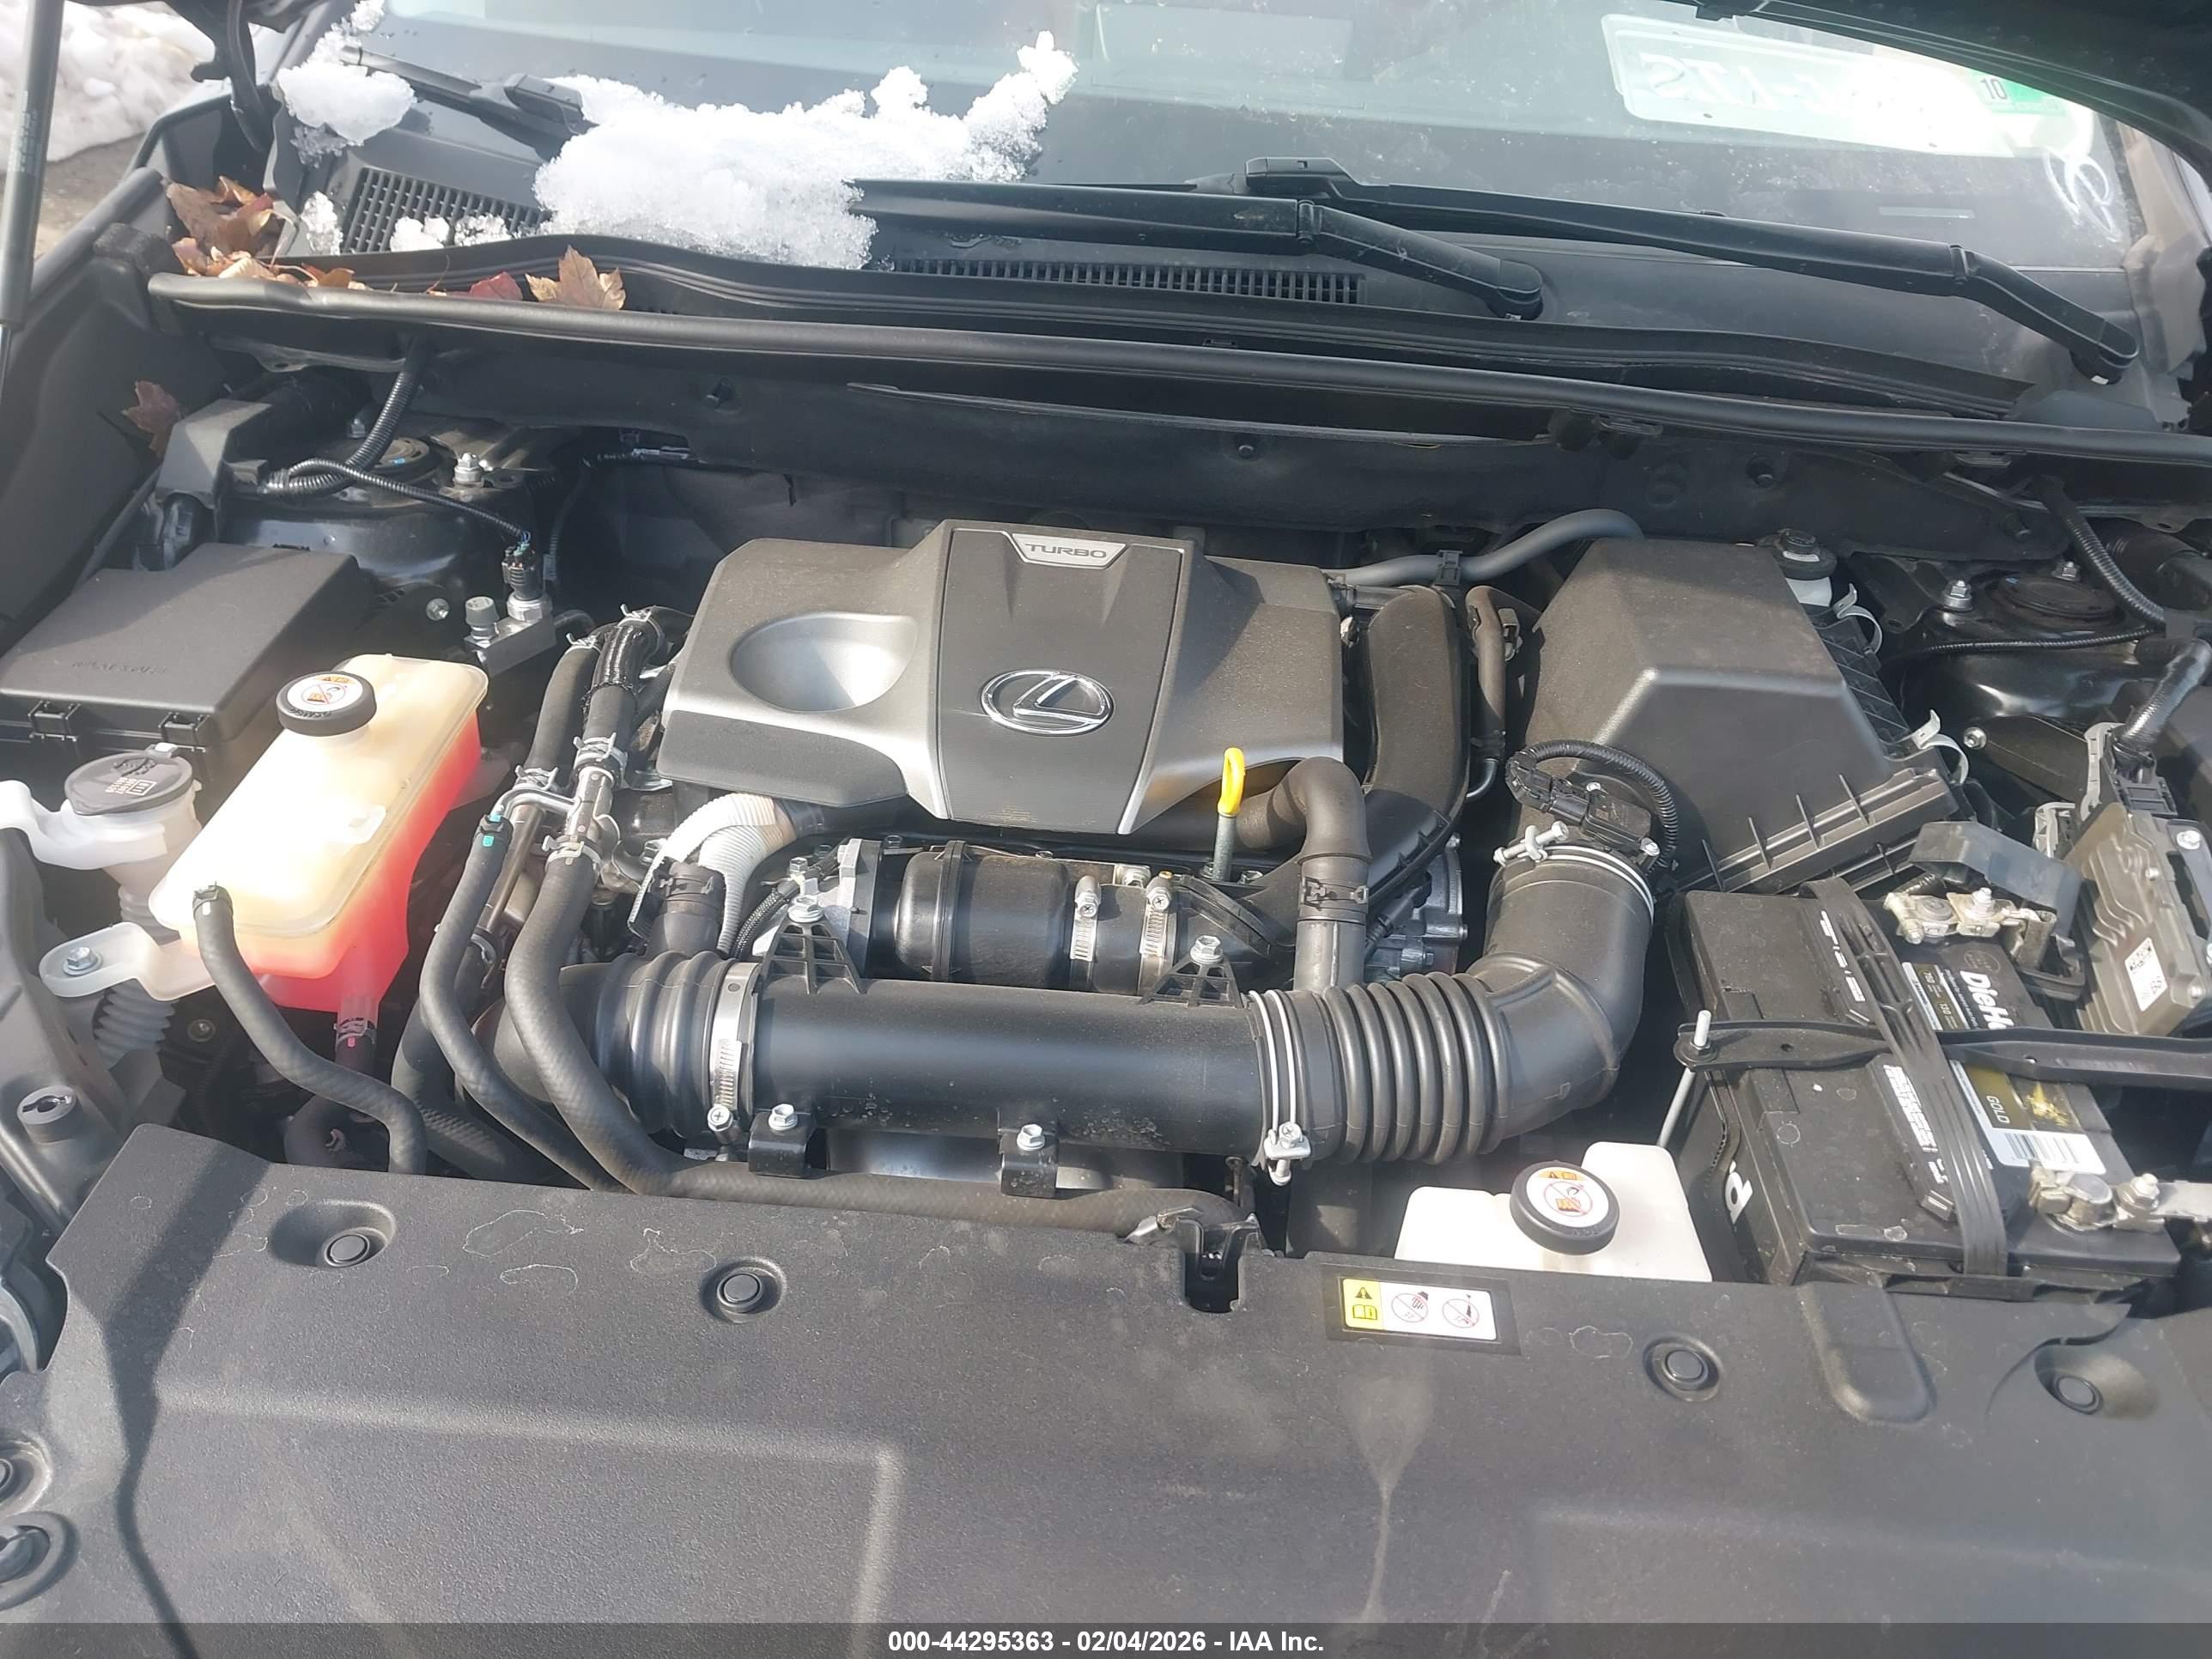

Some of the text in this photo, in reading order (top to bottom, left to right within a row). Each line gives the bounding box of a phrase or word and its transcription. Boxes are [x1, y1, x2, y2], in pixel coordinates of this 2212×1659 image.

[1980, 77, 2008, 100] 10
[1025, 543, 1108, 559] TURBO
[1985, 1095, 2011, 1125] GOLD
